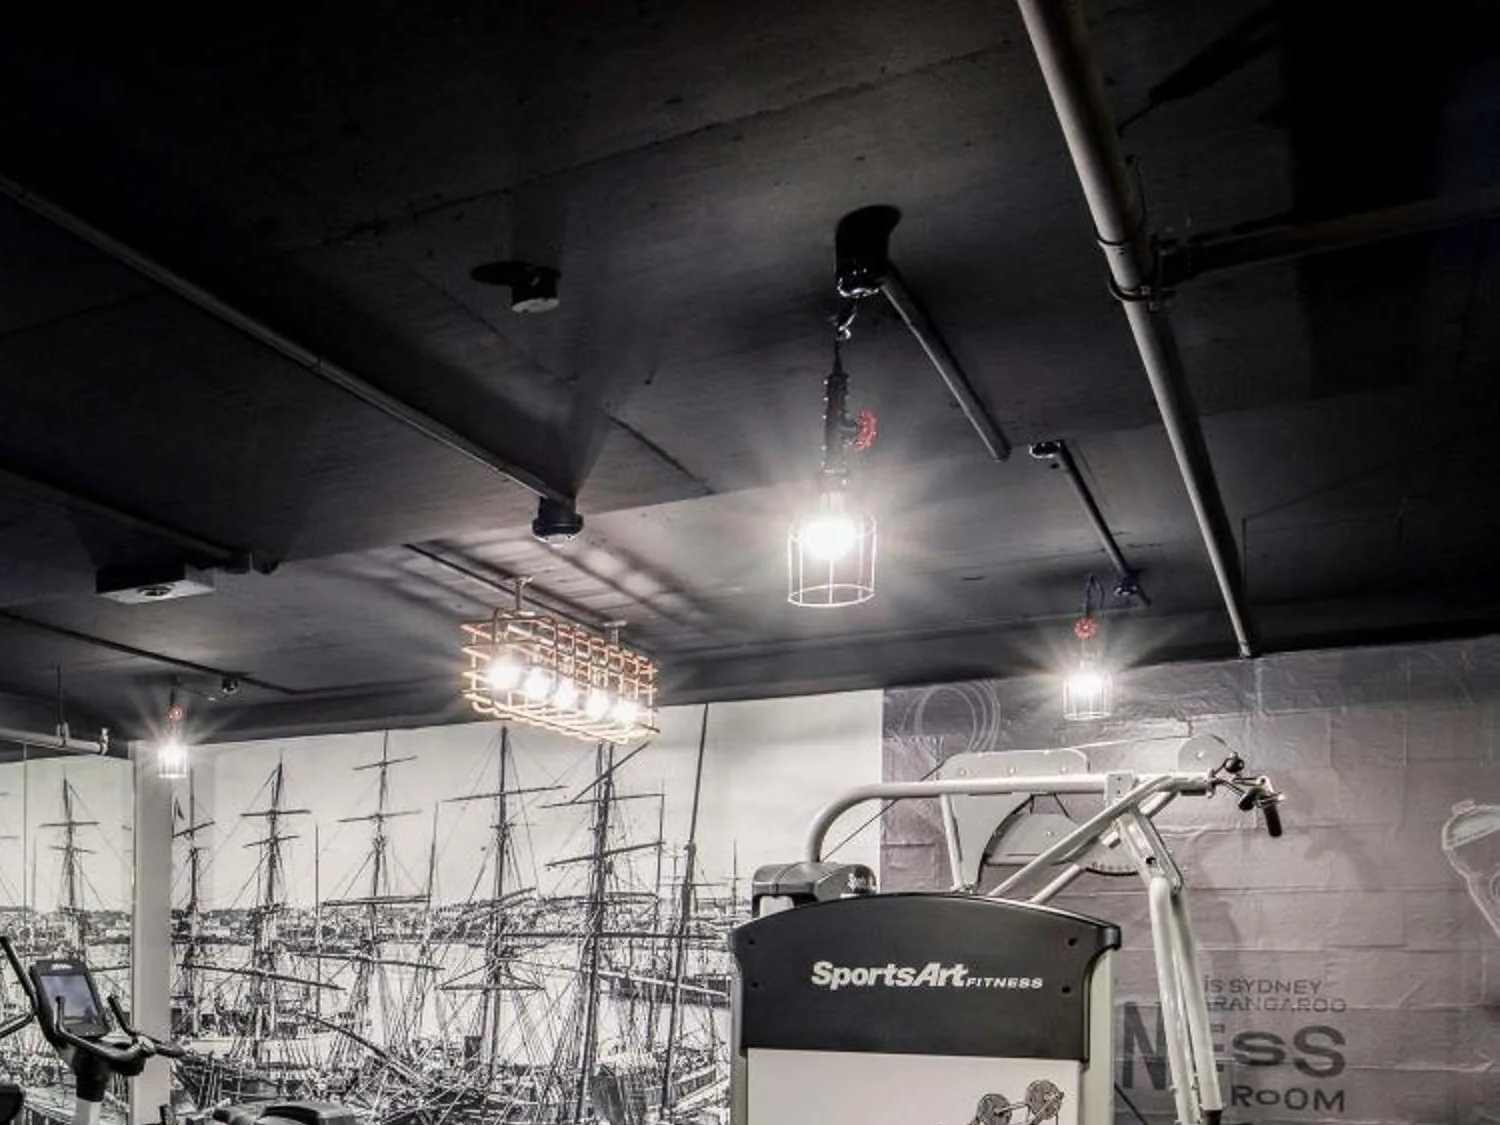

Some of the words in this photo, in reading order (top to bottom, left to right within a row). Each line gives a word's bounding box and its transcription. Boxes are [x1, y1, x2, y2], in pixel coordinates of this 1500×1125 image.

[811, 960, 969, 990] SportsArt
[965, 977, 1044, 989] FITNESS
[1229, 978, 1323, 995] SYDNEY
